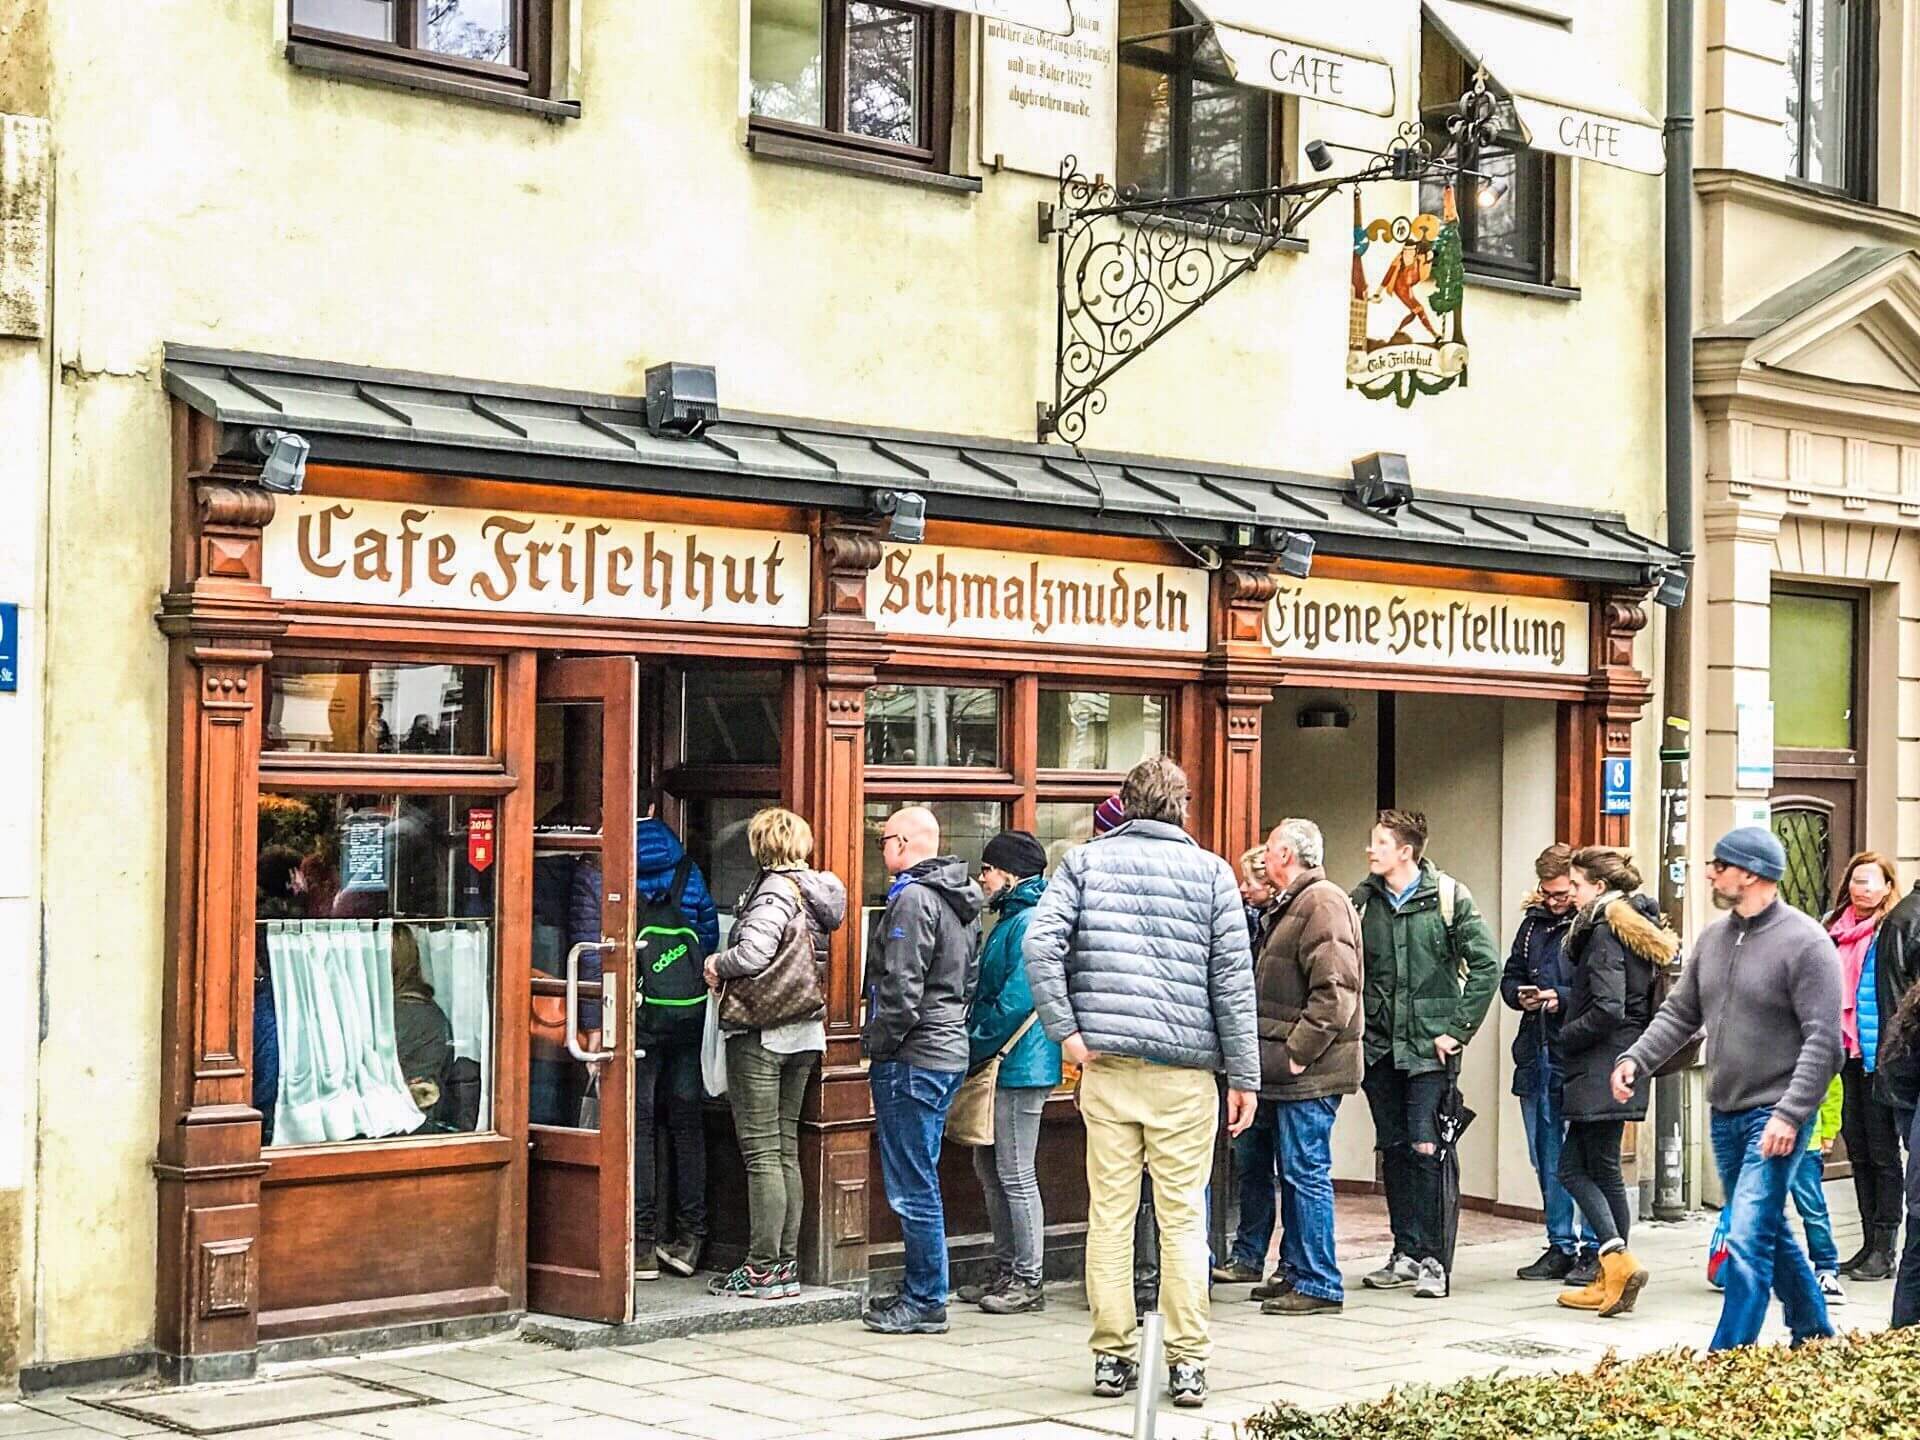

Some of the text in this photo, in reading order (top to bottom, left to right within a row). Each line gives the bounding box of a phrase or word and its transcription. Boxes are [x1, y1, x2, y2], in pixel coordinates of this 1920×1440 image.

[1007, 55, 1023, 73] und
[1270, 48, 1344, 95] CAFE
[1559, 116, 1621, 158] CAFE
[297, 504, 457, 598] Cafe
[880, 548, 1190, 635] Schmalznudeln
[1264, 586, 1382, 649] Eigene
[1613, 762, 1625, 788] 8
[652, 943, 687, 973] adidas
